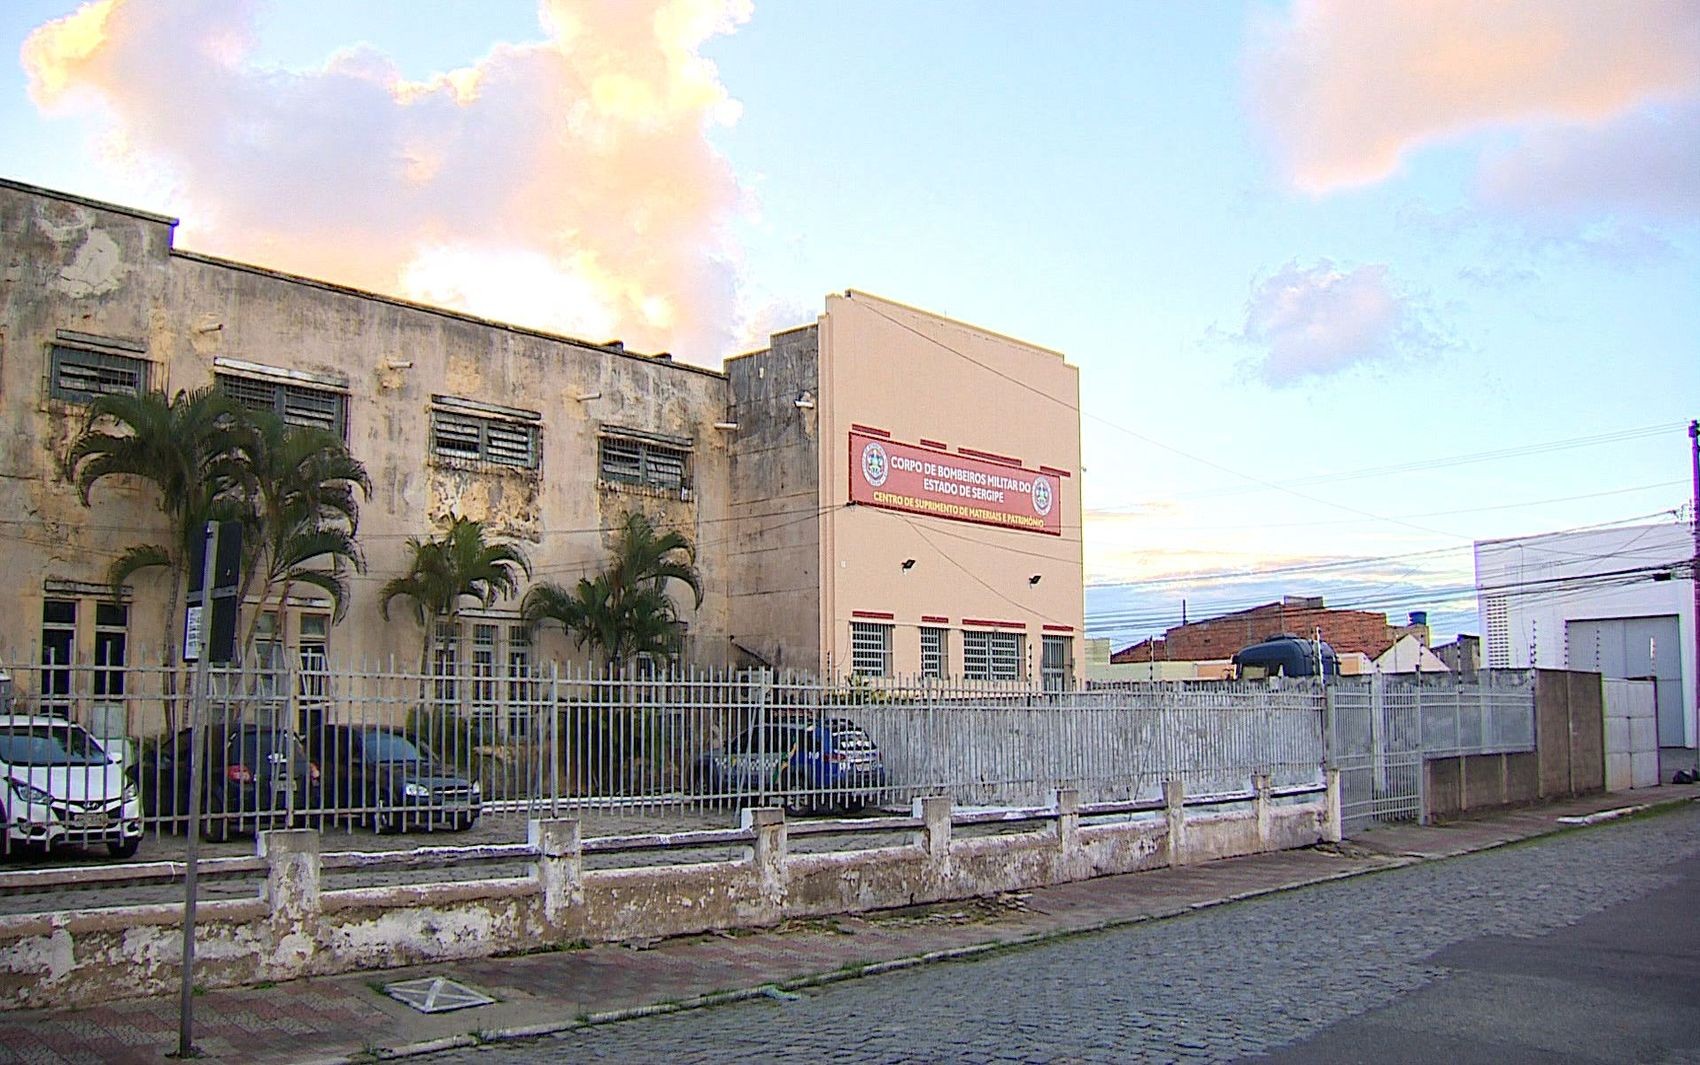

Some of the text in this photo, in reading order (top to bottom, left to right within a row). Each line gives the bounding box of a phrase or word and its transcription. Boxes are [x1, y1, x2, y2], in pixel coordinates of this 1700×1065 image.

[891, 456, 1031, 493] CORPO DE BOMBEIROS MILITAR DO
[923, 478, 1004, 503] ESTADO DE SERGIPE
[873, 491, 903, 505] CENTRO
[904, 496, 914, 507] DE
[914, 499, 959, 515] SUPRIMENTO
[959, 506, 969, 516] DE
[969, 508, 1002, 521] MATERIAIS
[1002, 513, 1007, 522] E
